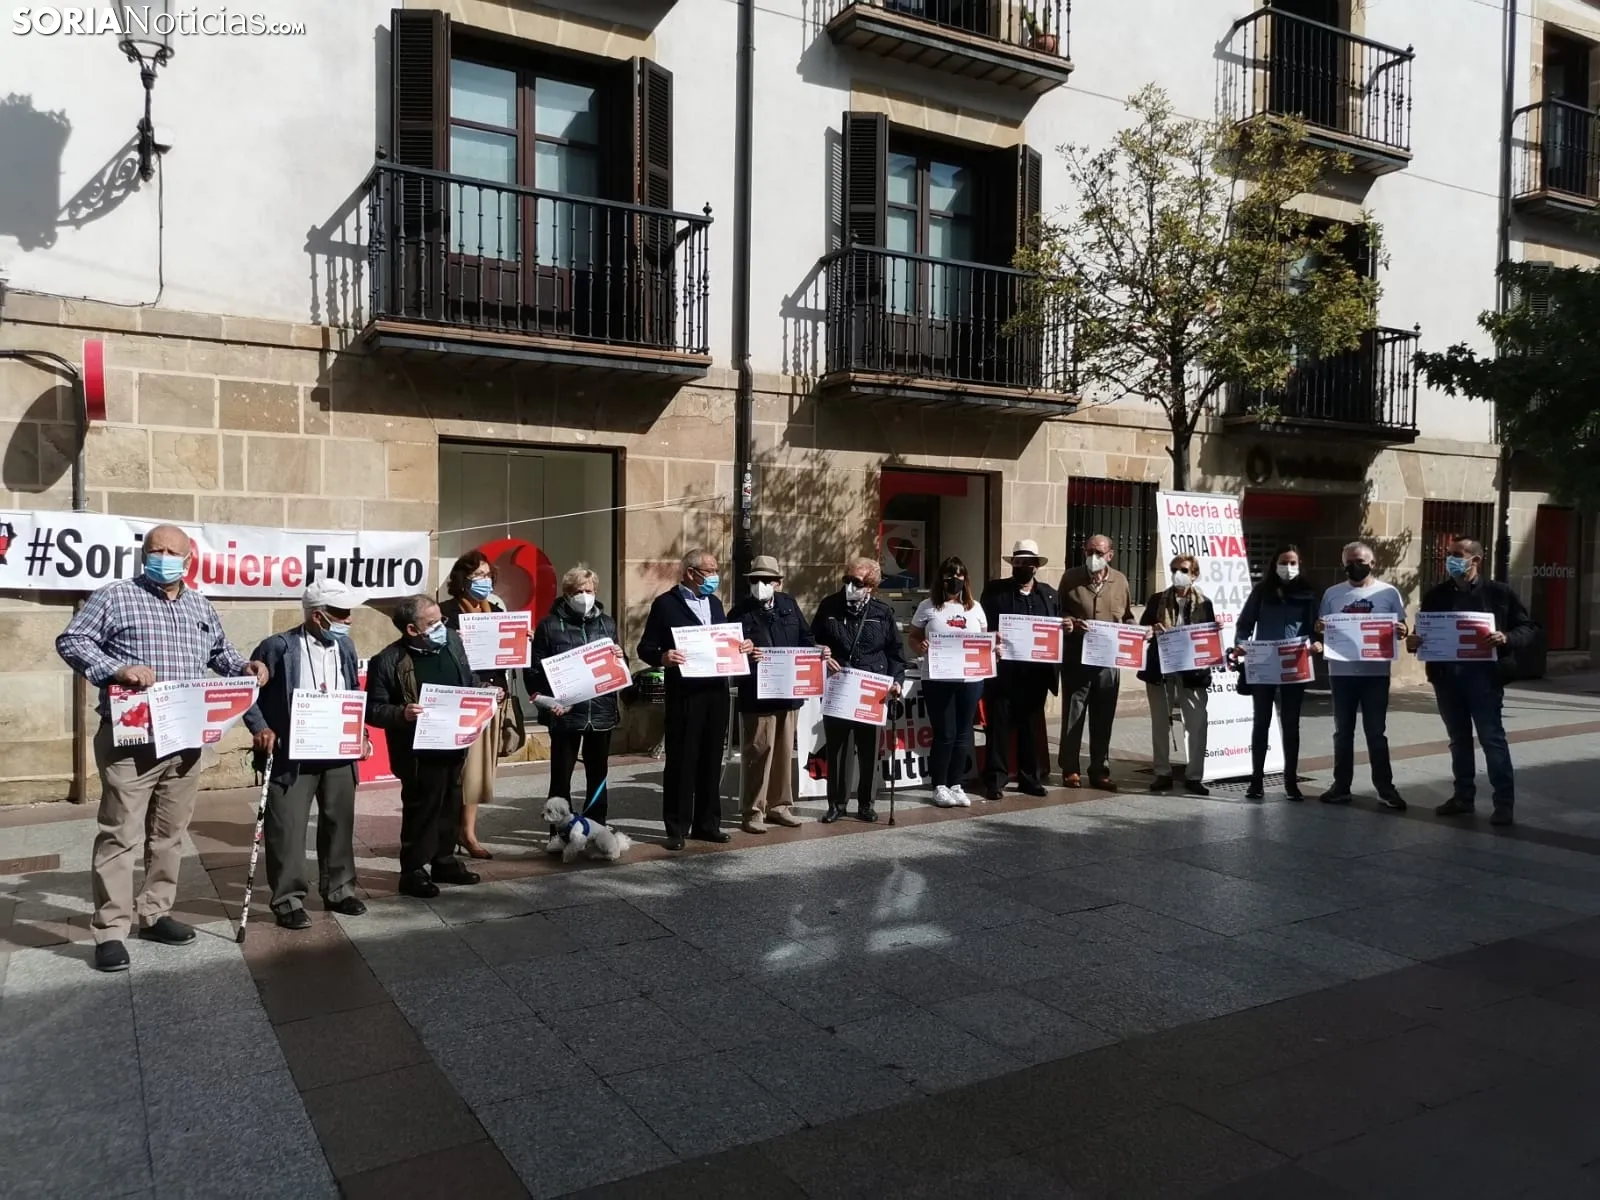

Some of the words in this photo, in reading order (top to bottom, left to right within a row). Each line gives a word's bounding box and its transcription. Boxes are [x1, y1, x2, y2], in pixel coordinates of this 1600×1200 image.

[1224, 503, 1241, 520] de
[1167, 517, 1223, 535] Navidad
[25, 526, 424, 589] #SoriQuiereFuturo
[1531, 561, 1576, 579] odafone
[163, 682, 190, 691] España
[1226, 683, 1238, 692] cu
[887, 690, 926, 721] ori
[1207, 718, 1225, 726] racias
